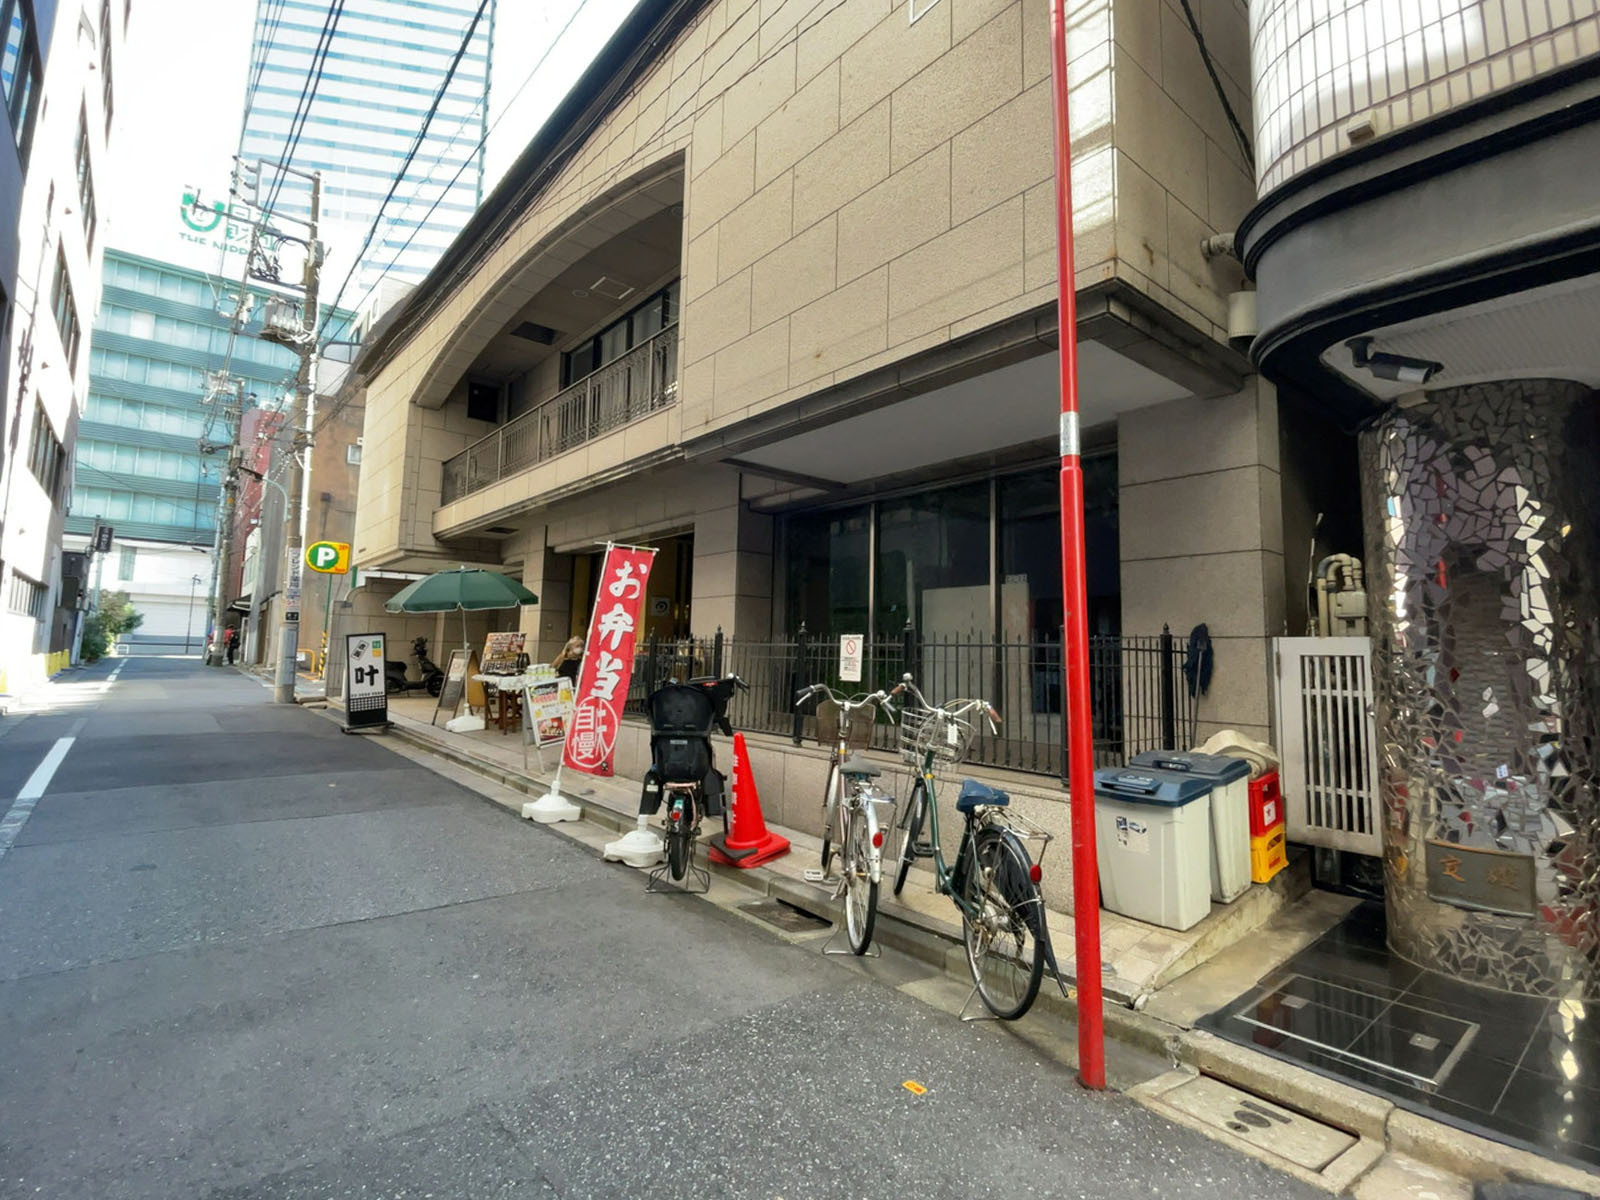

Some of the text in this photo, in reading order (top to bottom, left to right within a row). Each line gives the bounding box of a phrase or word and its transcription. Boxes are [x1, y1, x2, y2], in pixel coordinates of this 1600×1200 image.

[316, 547, 336, 567] P
[590, 560, 648, 701] お弁当
[354, 664, 379, 687] 叶
